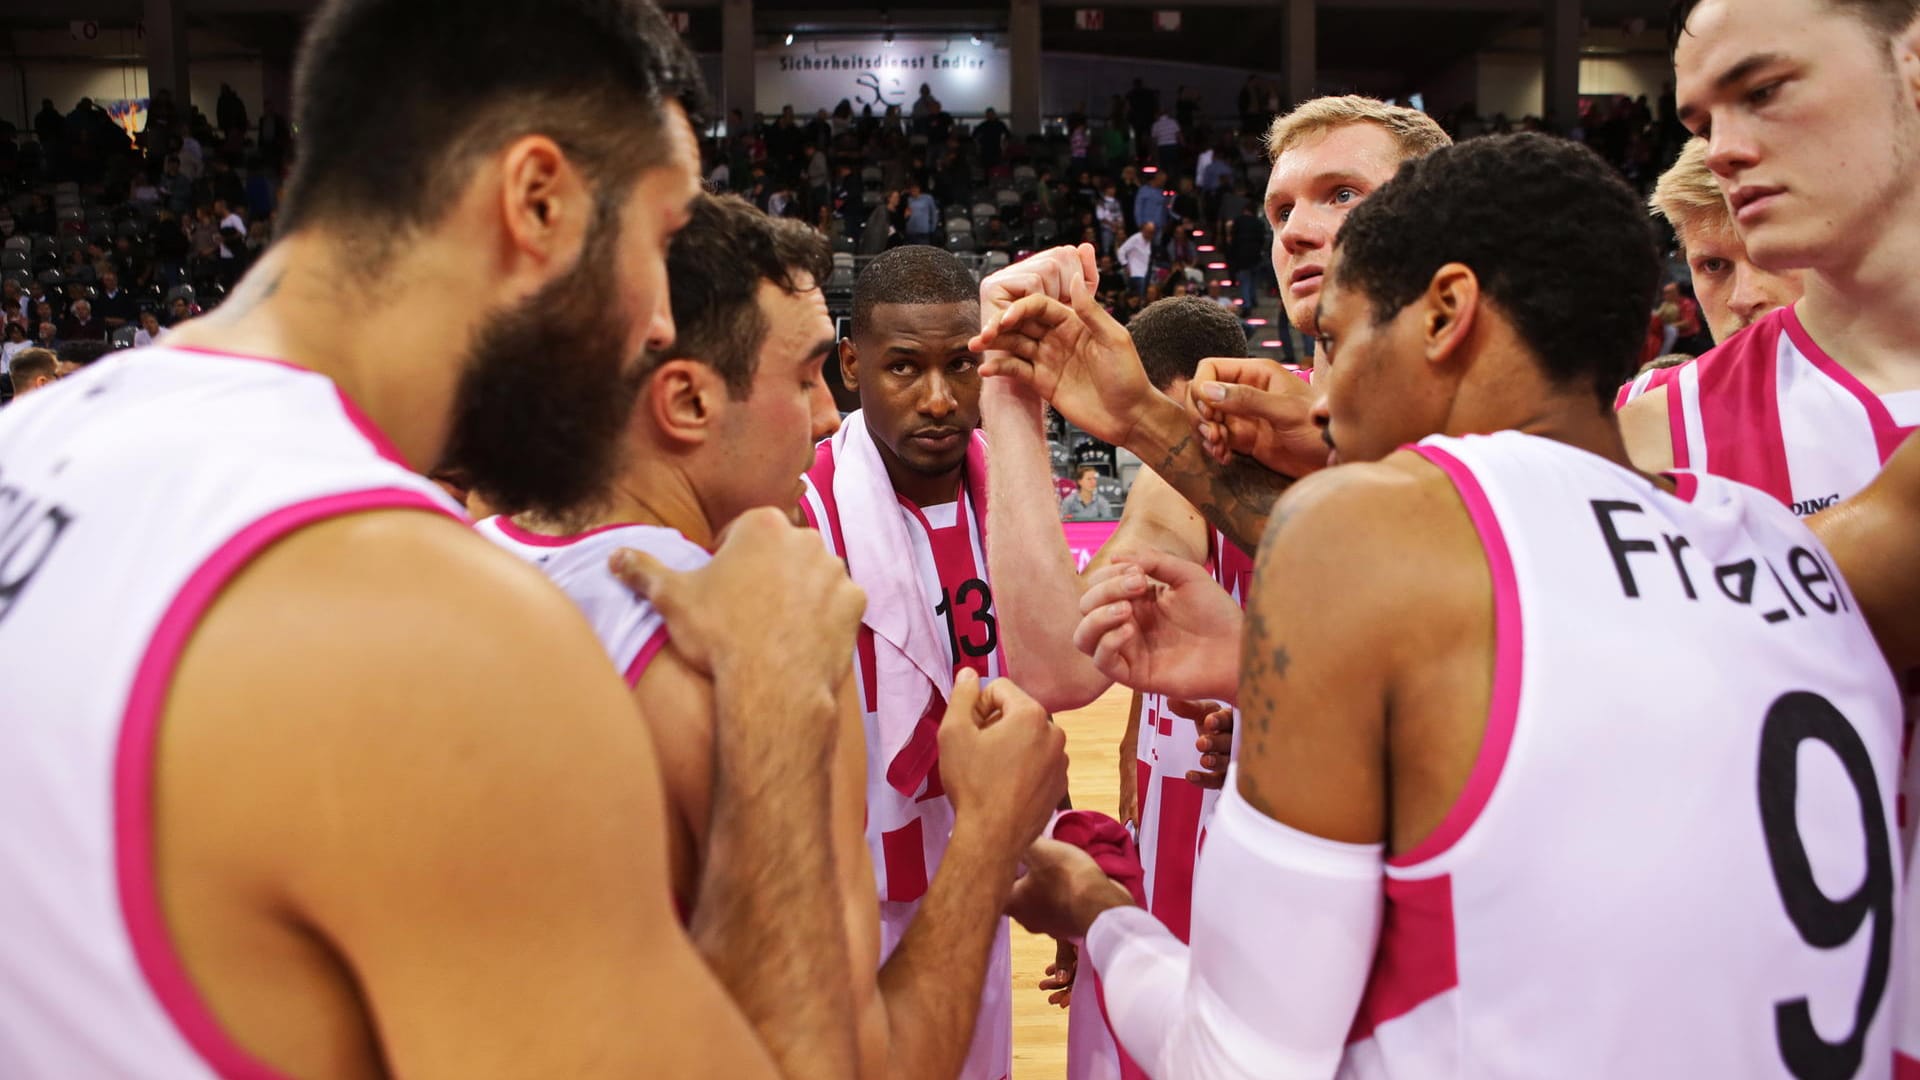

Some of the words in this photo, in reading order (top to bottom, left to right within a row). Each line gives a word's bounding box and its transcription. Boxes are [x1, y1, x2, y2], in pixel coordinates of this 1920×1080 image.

[779, 54, 925, 71] Sicherheitsdienst
[932, 54, 984, 71] Endler
[1791, 493, 1839, 516] DING
[1590, 499, 1849, 624] Fraie
[935, 578, 997, 664] 13
[1757, 690, 1894, 1080] 9
